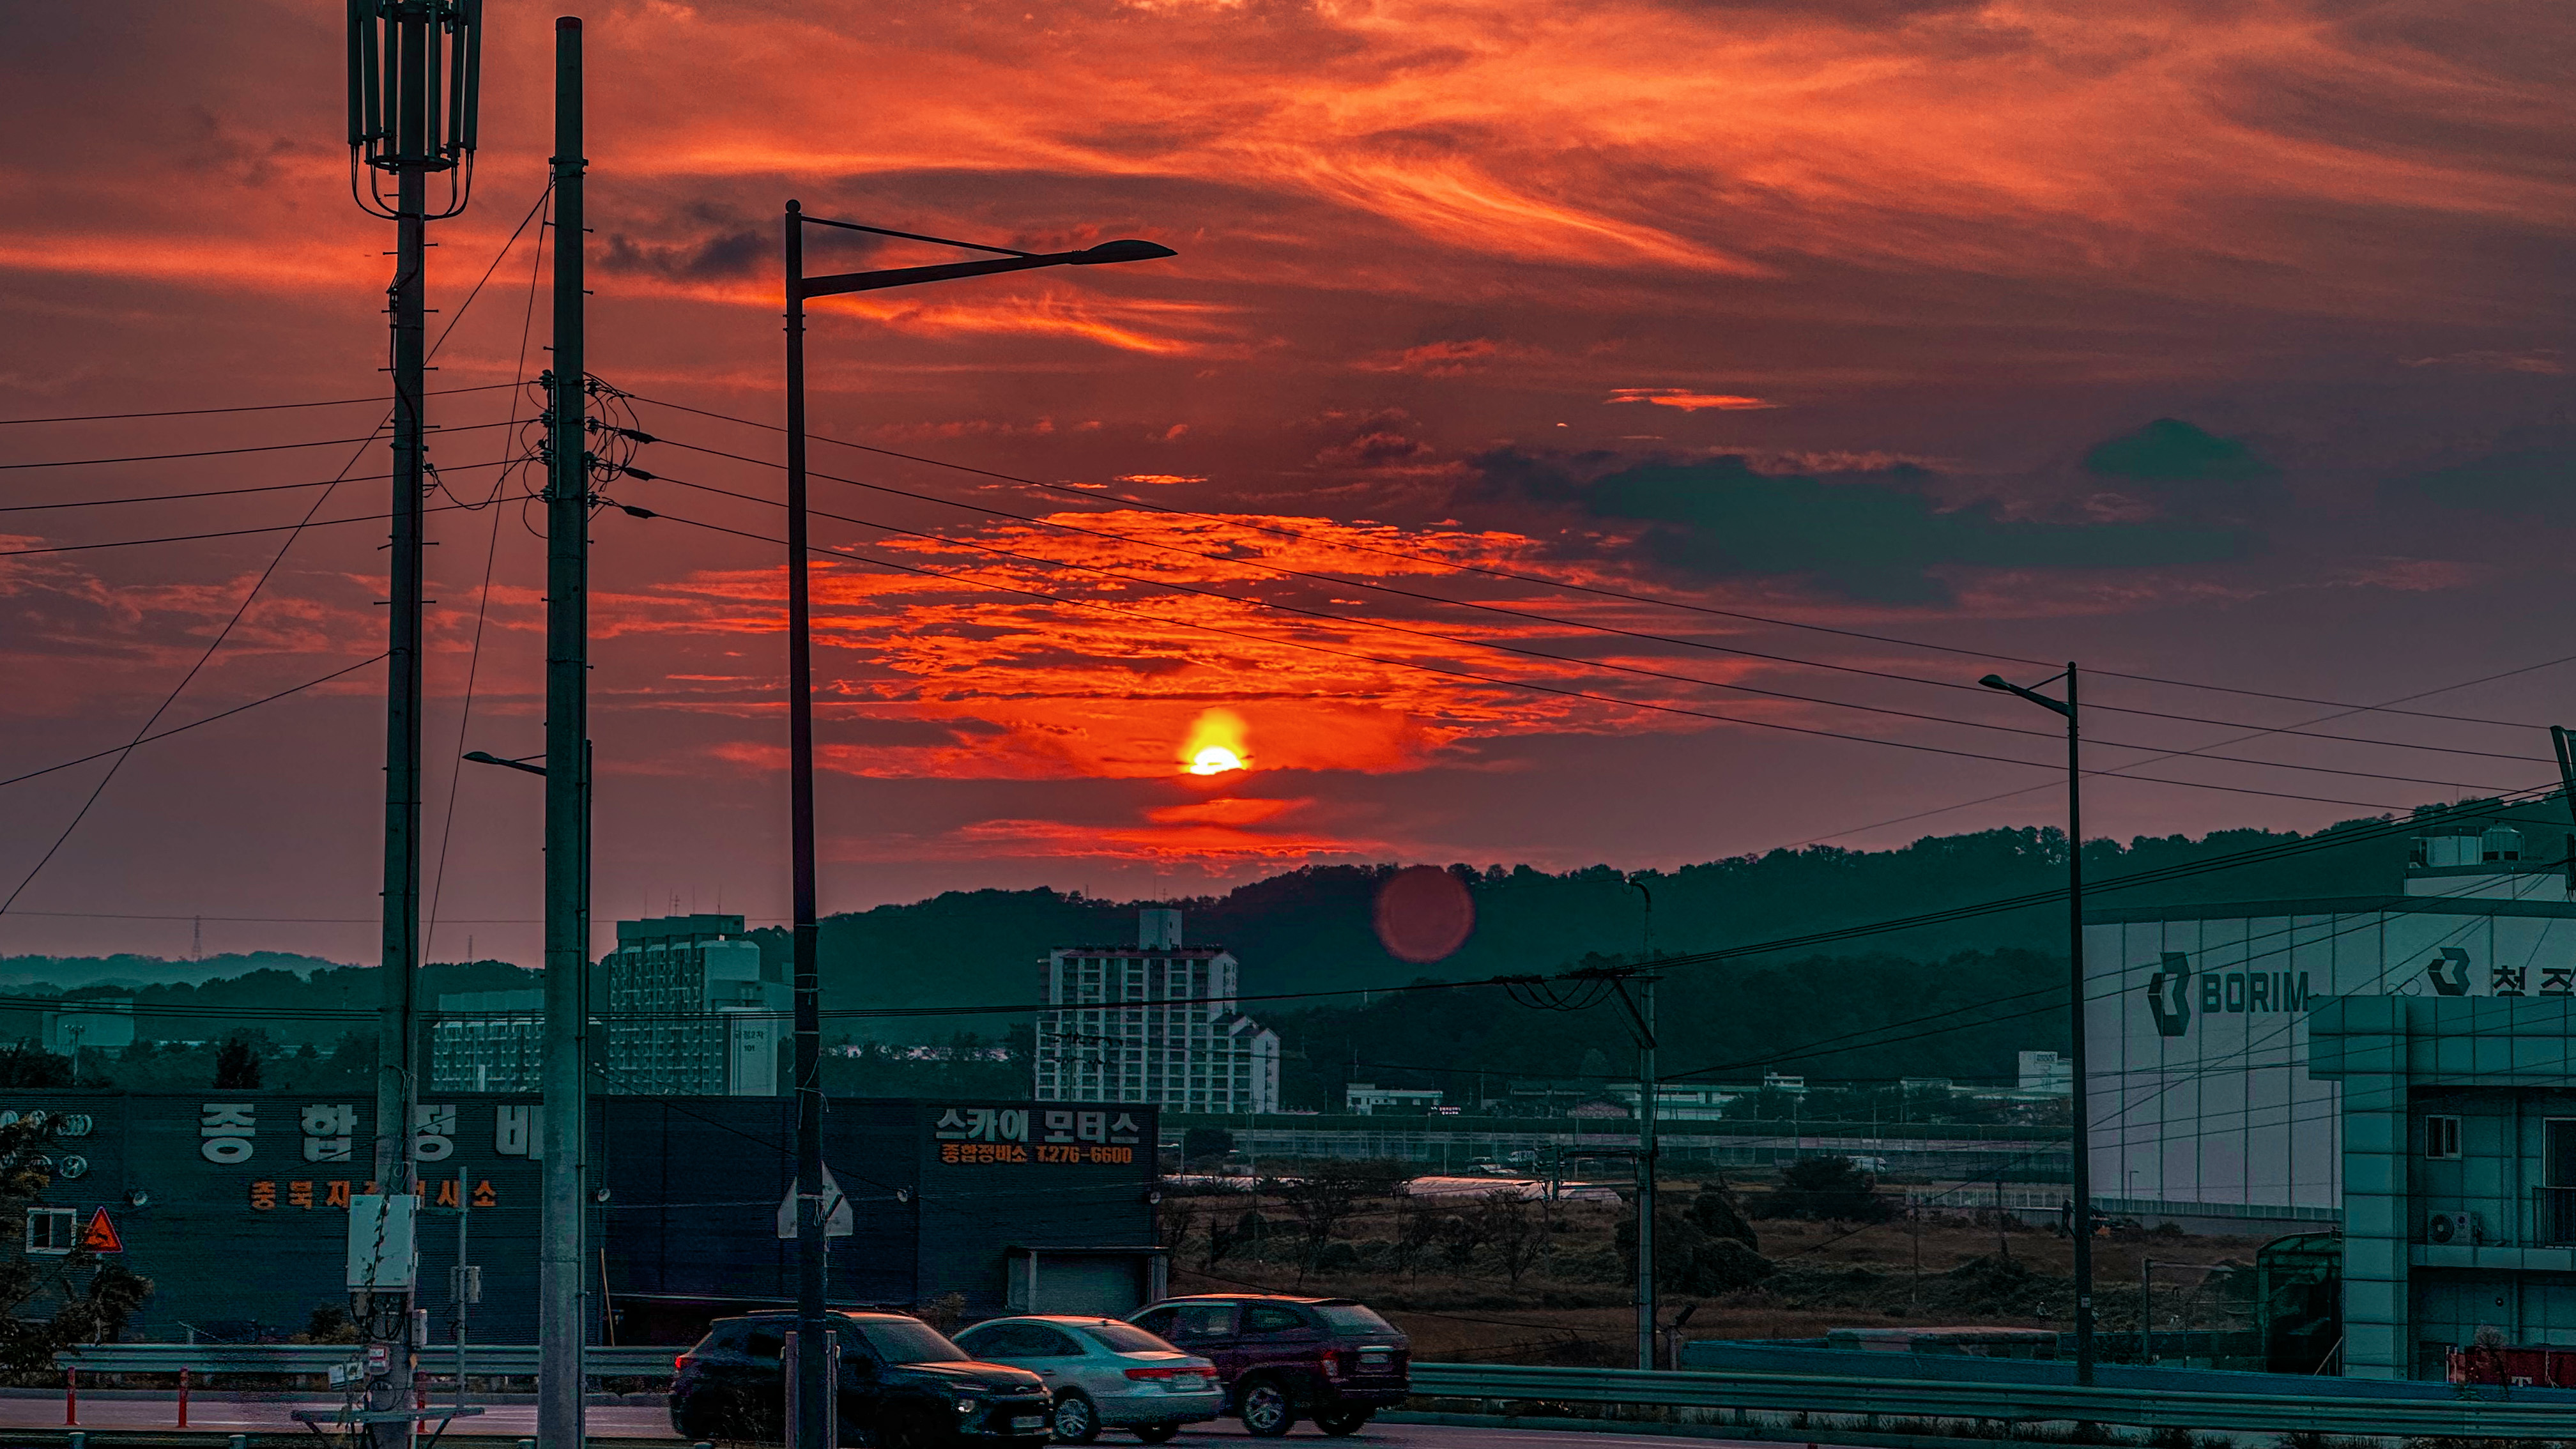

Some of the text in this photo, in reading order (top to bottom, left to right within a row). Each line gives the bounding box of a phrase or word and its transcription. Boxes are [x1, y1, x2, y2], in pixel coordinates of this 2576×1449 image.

[2201, 970, 2309, 1013] BORIM
[935, 1108, 1140, 1144] 스카이 모터스
[941, 1144, 1028, 1163] 종합정비소
